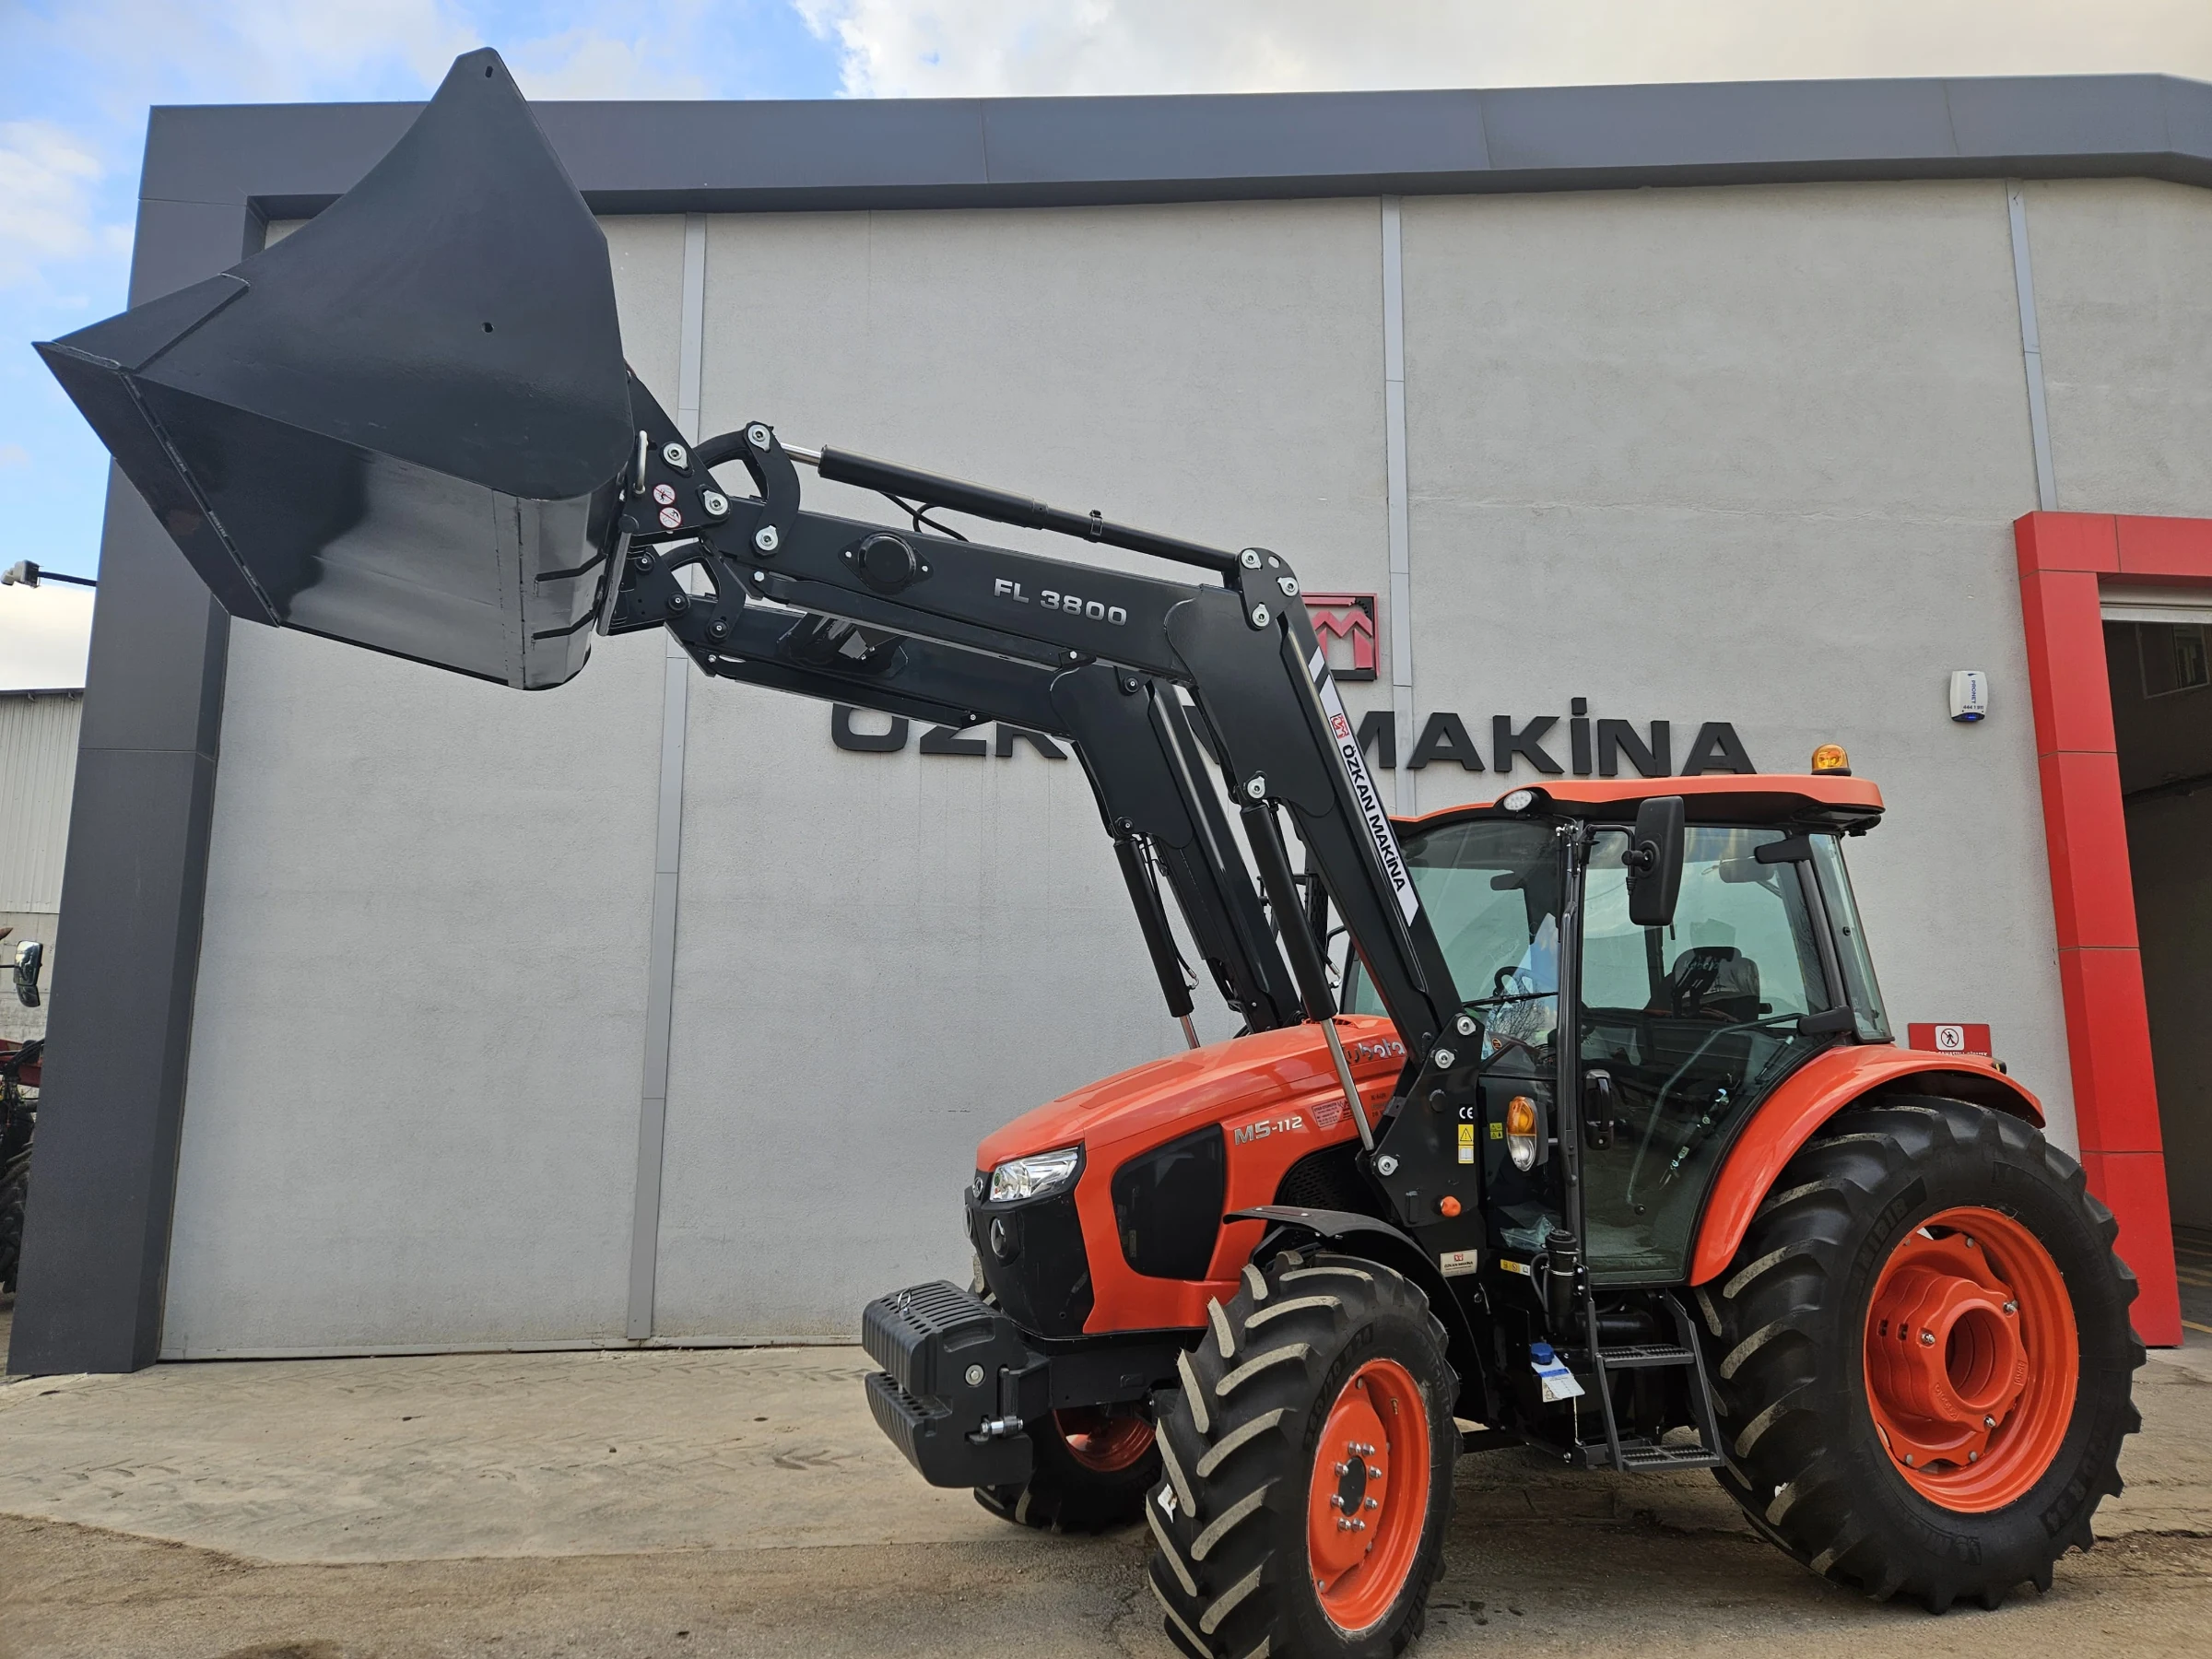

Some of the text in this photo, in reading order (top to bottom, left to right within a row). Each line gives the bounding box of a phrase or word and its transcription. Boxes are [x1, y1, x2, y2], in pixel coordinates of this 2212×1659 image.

[994, 578, 1127, 627] FL 3800
[1342, 744, 1406, 893] ÖZKAN MAKİNA
[1234, 1116, 1303, 1146] M5-112
[1459, 1107, 1474, 1119] CE
